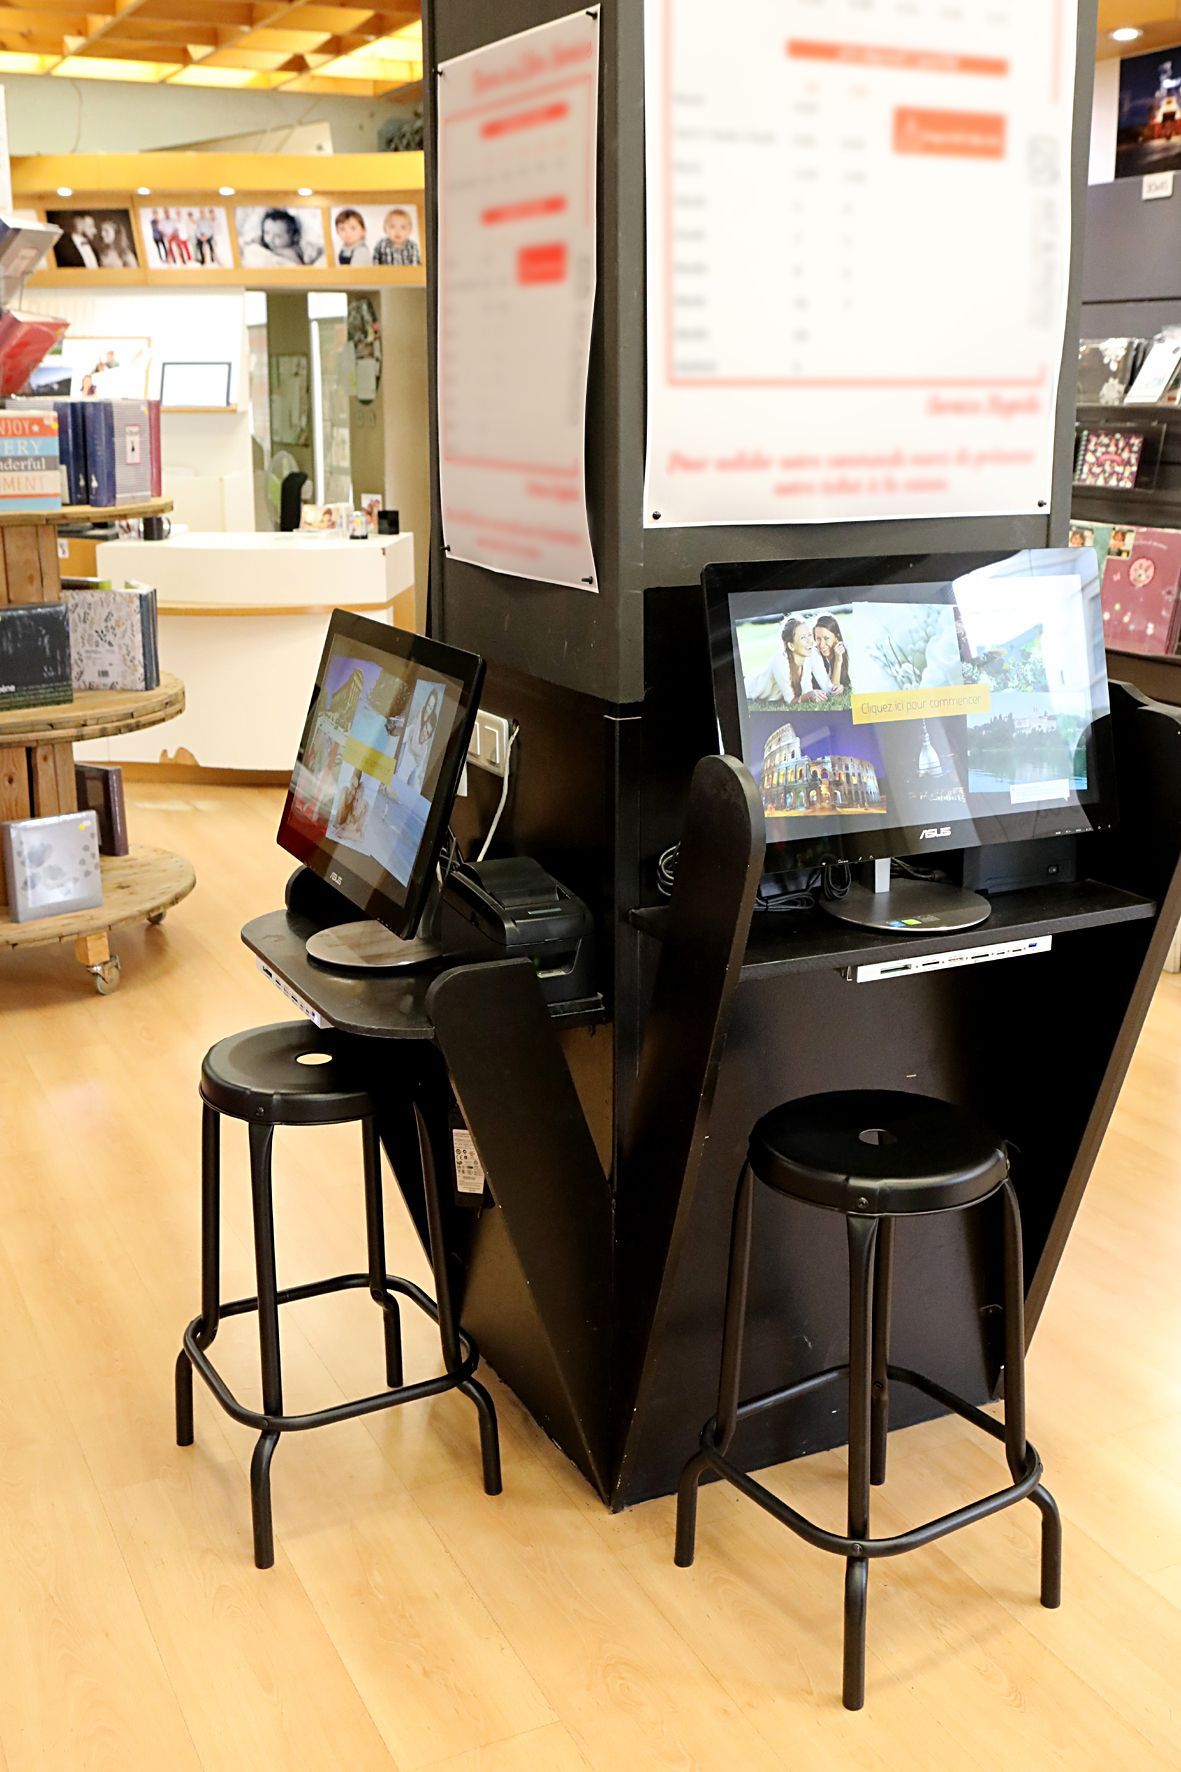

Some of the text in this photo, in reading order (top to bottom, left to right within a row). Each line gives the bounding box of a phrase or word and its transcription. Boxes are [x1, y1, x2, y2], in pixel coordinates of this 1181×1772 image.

[861, 695, 981, 715] Cliquez ici pour commencer
[919, 826, 952, 840] ASUS
